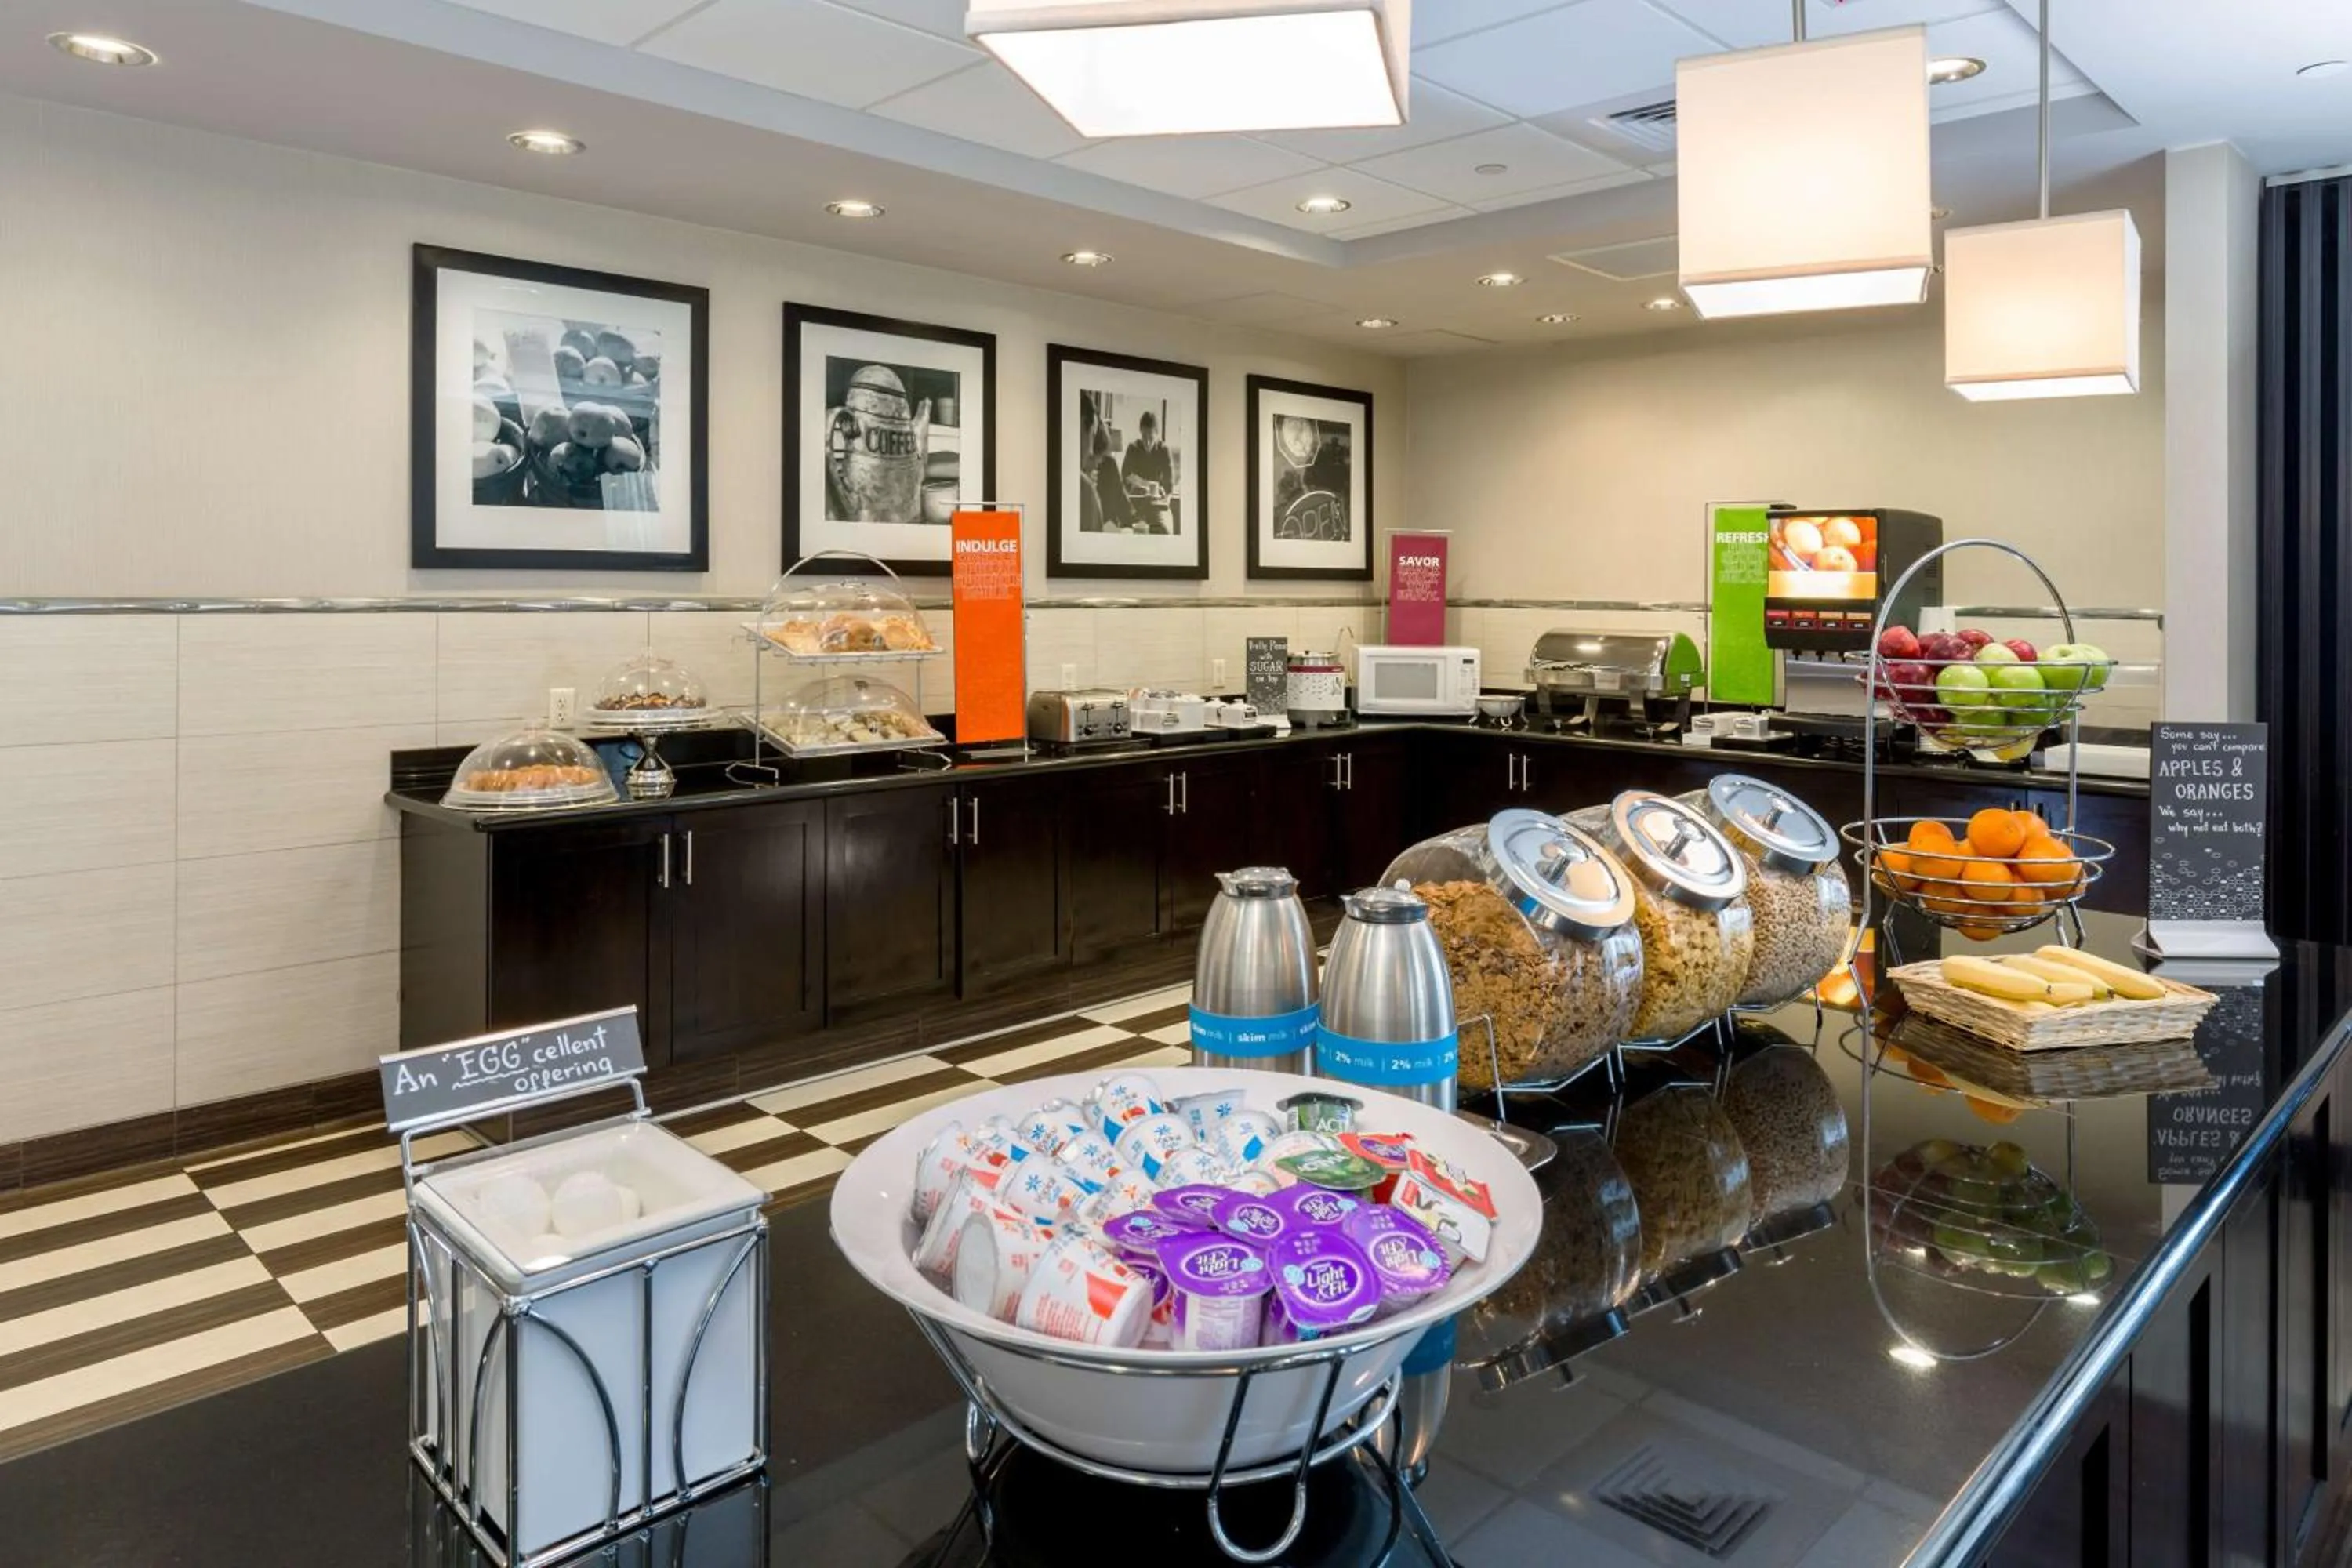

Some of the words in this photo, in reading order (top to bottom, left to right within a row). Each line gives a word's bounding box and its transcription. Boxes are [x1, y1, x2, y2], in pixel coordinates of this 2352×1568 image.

[955, 539, 1018, 553] INDULGE
[1399, 556, 1440, 567] SAVOR
[1249, 660, 1283, 672] SUGAR
[2160, 727, 2194, 739] Some
[2171, 742, 2188, 754] you
[2193, 741, 2218, 752] can't
[2223, 742, 2265, 757] compare
[2158, 760, 2223, 777] APPLES
[2230, 757, 2244, 778] &
[2175, 783, 2255, 800] ORANGES
[2158, 804, 2176, 818] We
[2167, 822, 2189, 838] why
[2193, 821, 2209, 833] not
[2212, 821, 2228, 833] eat
[2233, 822, 2263, 837] both?
[1237, 1032, 1266, 1042] skim
[394, 1063, 438, 1096] An
[533, 1025, 608, 1064] cellent
[1335, 1050, 1351, 1065] 2%
[1392, 1059, 1411, 1070] 2%
[514, 1057, 614, 1093] offering
[1307, 1265, 1345, 1289] Light
